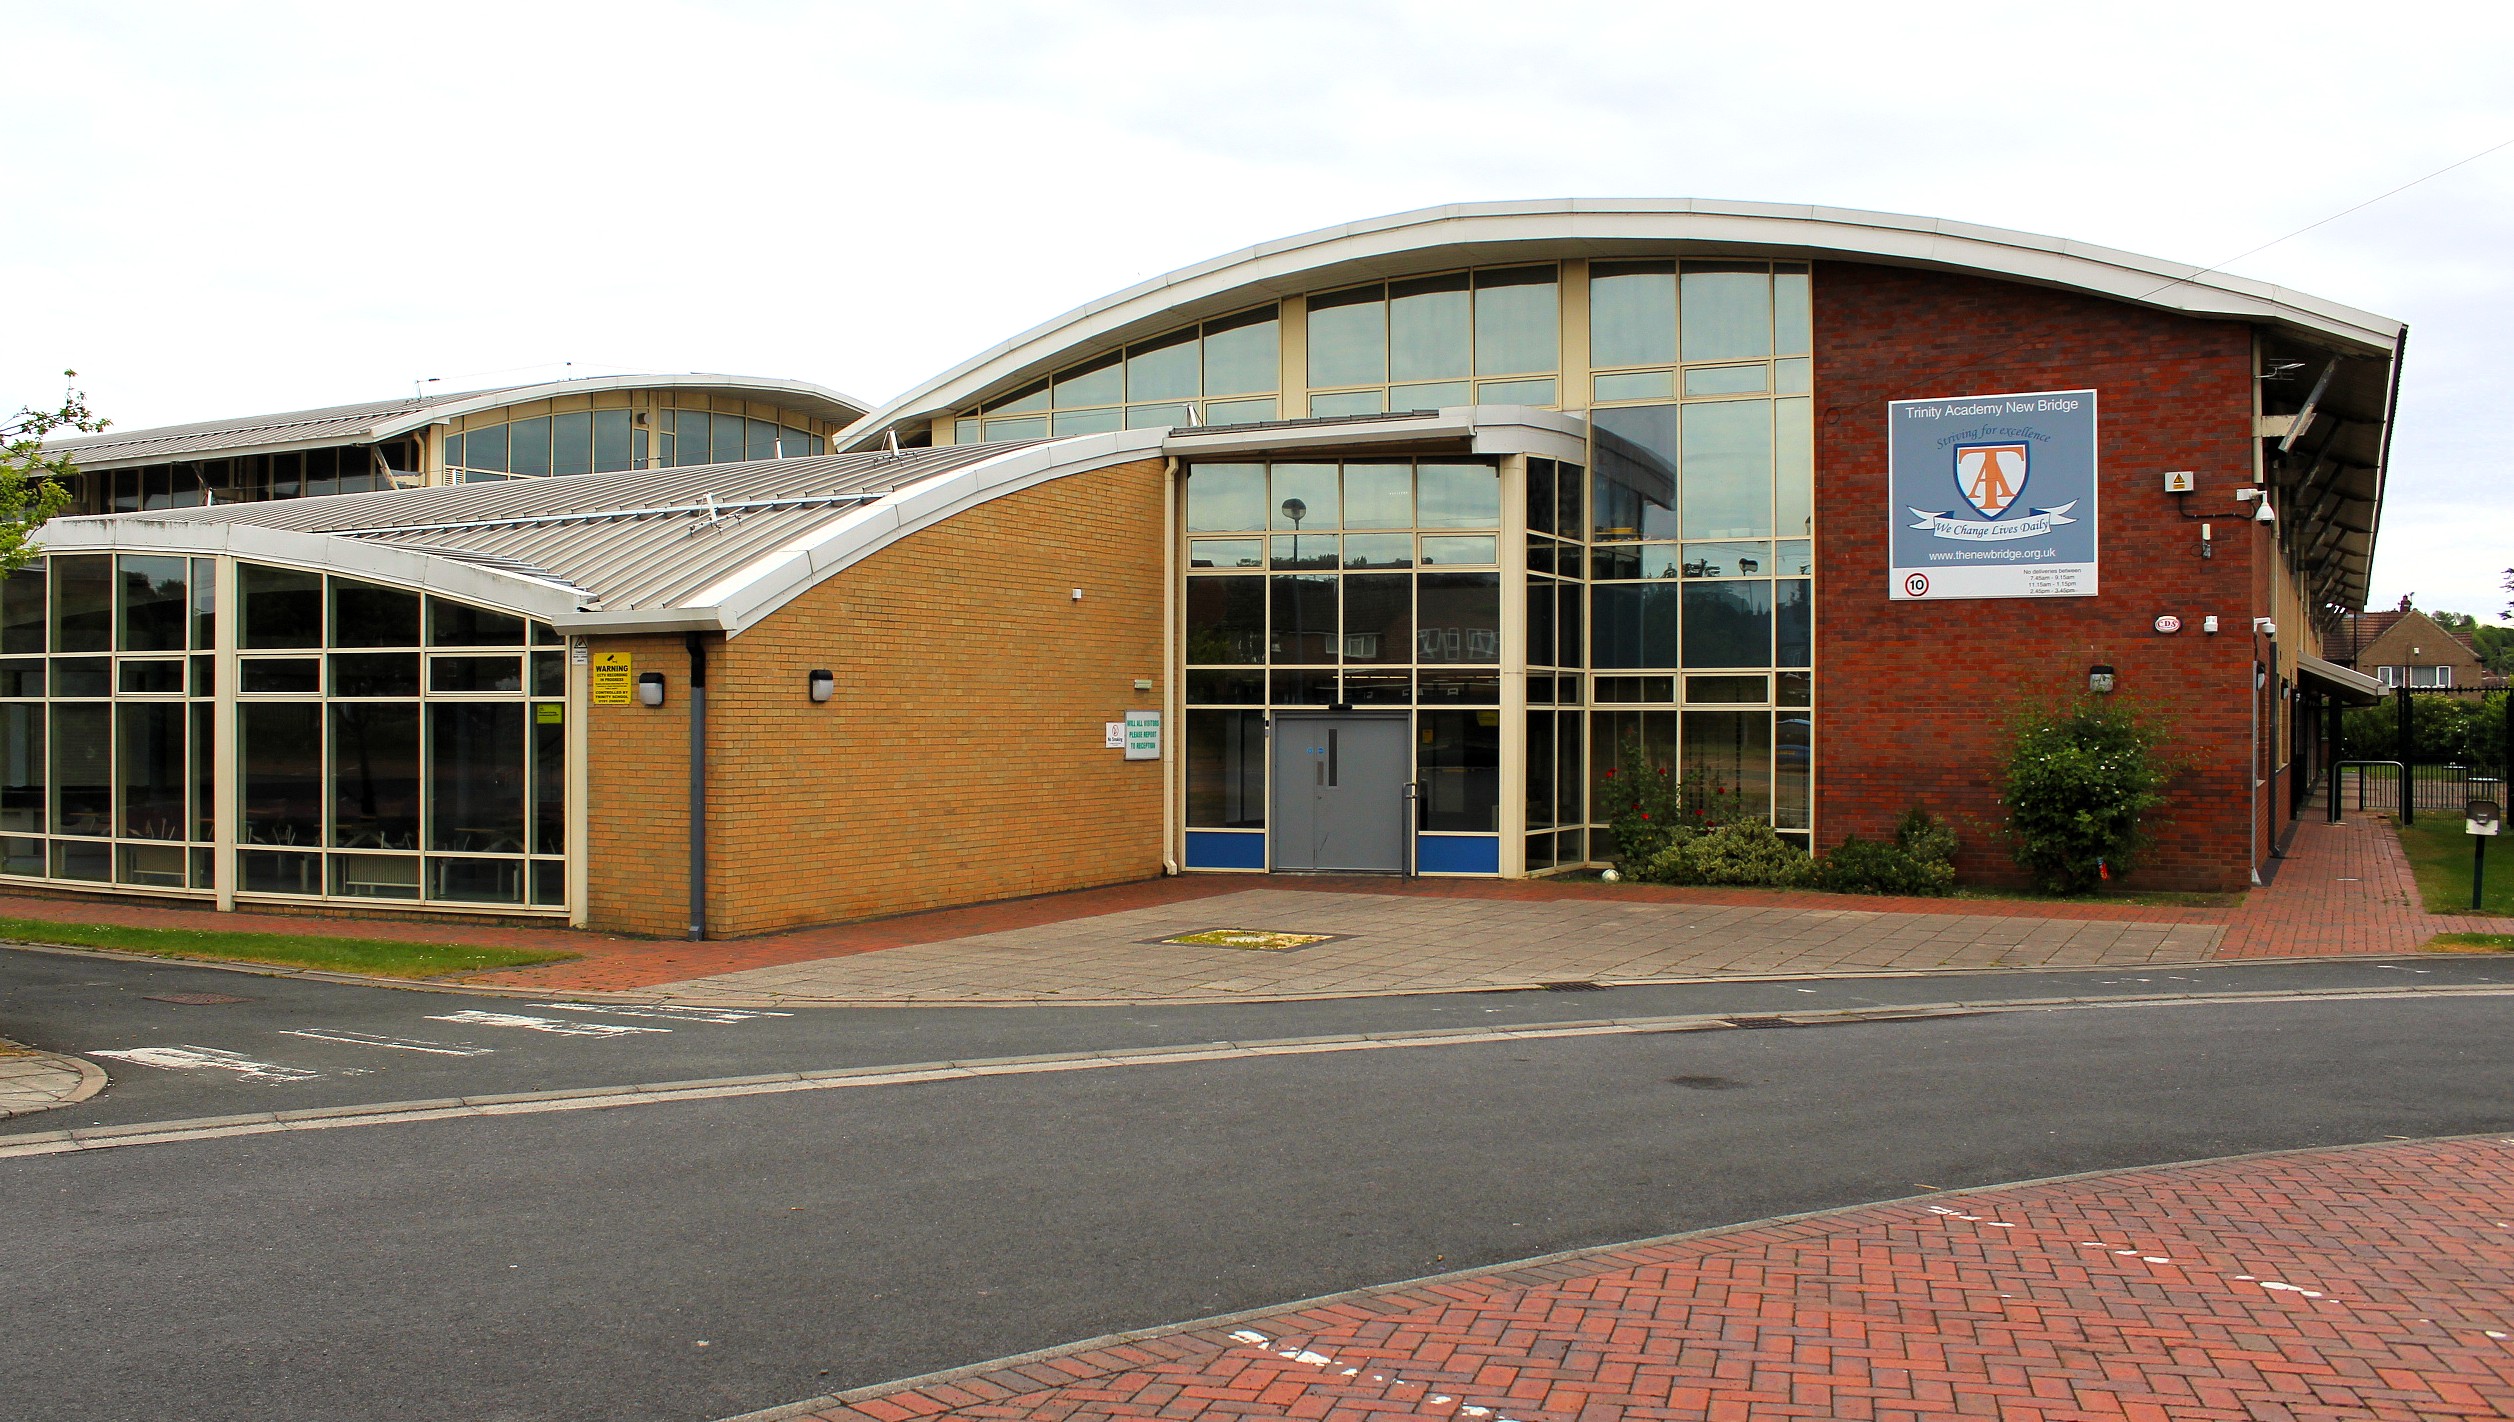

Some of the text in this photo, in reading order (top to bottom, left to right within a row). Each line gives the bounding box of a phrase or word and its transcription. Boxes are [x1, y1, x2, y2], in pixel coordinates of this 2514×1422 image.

[1905, 399, 2079, 420] Trinity Academy New Bridge
[1937, 423, 2051, 450] Striving for excellence
[1935, 518, 2048, 538] We Change Lives Daily
[1929, 547, 2056, 561] www.thenewbridge.org.uk
[1909, 579, 1924, 590] 10
